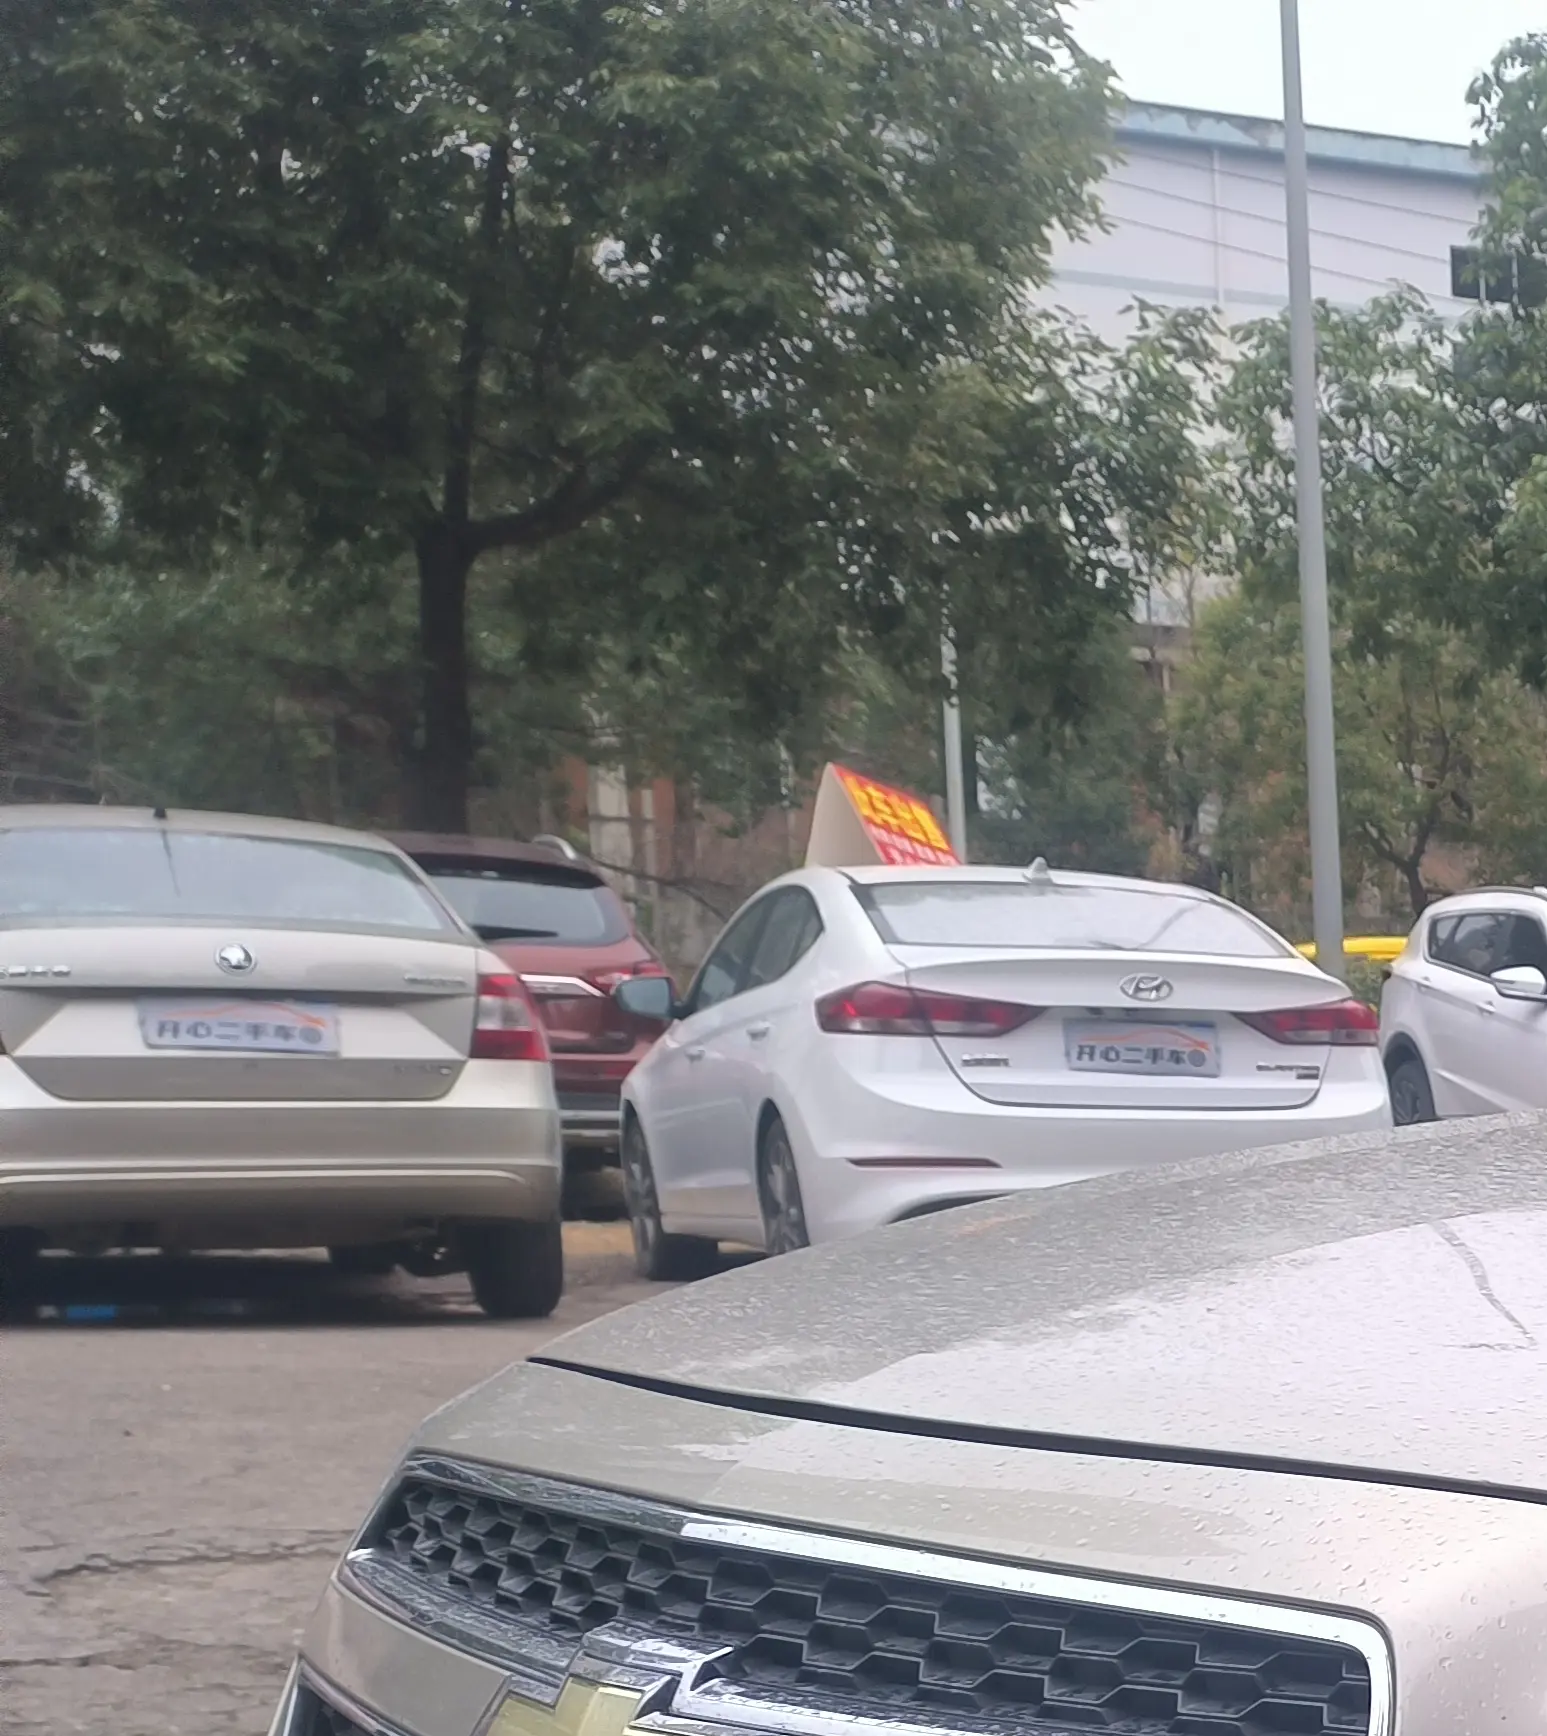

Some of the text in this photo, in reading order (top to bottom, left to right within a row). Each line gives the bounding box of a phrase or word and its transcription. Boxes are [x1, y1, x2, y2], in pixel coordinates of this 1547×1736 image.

[1077, 1045, 1187, 1065] 开心二手车
